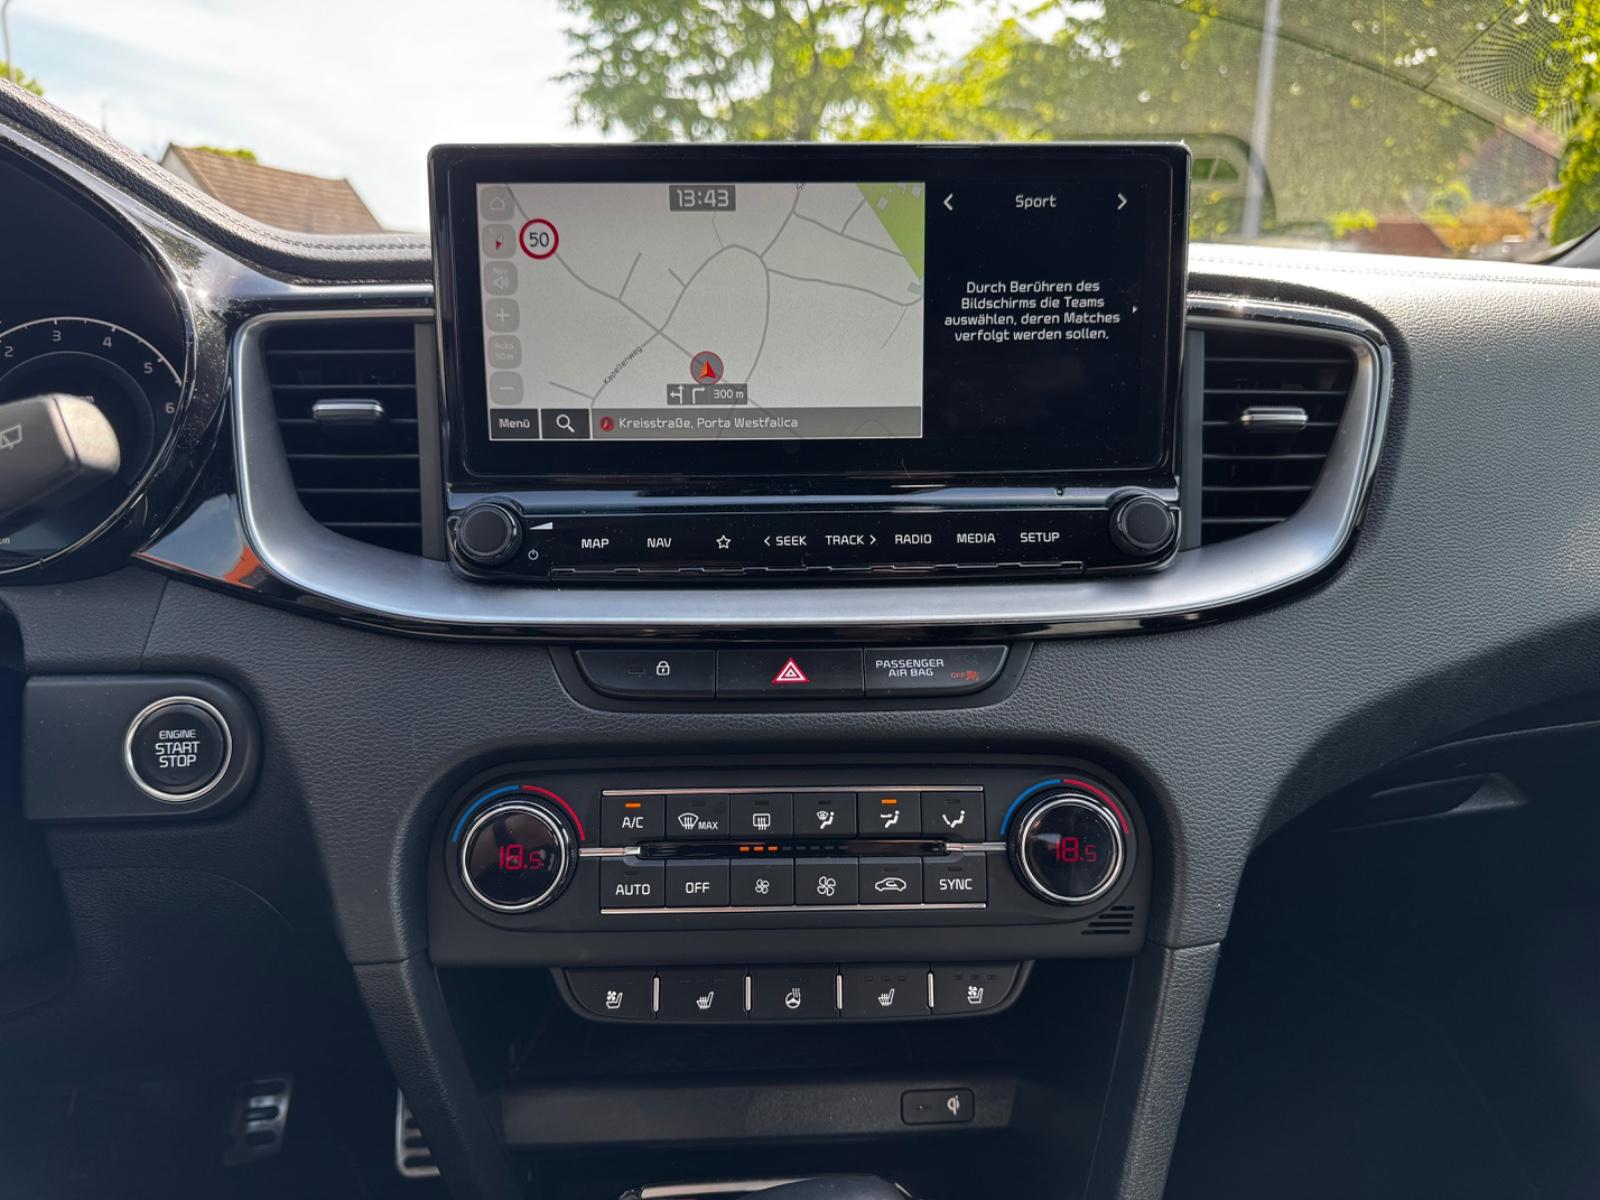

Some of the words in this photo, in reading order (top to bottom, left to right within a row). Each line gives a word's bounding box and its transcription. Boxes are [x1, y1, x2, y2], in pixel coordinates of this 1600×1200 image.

[676, 188, 729, 208] 13:43
[1015, 194, 1056, 210] Sport
[528, 231, 550, 247] 50
[966, 281, 1006, 294] Durch
[1010, 280, 1072, 293] Berühren
[1076, 280, 1100, 292] des
[961, 297, 1036, 309] Bildschirms
[1040, 297, 1060, 309] die
[1064, 296, 1105, 308] Teams
[944, 313, 1017, 326] auswählen,
[1021, 313, 1060, 325] deren
[1064, 312, 1121, 324] Matches
[52, 330, 61, 342] 3
[955, 329, 1010, 343] verfolgt
[1013, 328, 1062, 341] werden
[1065, 327, 1109, 340] sollen.
[102, 337, 112, 349] 4
[4, 346, 14, 358] 2
[144, 363, 153, 374] 5
[602, 345, 643, 385] Kapellenweg
[713, 389, 734, 399] 300
[736, 391, 744, 399] m
[165, 403, 175, 414] 6
[499, 417, 530, 429] Menü
[619, 416, 694, 430] Kreisstraße,
[697, 416, 731, 429] Porta
[734, 416, 798, 429] Westfalica
[647, 537, 672, 548] NAV
[775, 535, 807, 547] SEEK
[825, 534, 865, 546] TRACK
[895, 533, 932, 545] RADIO
[956, 532, 996, 544] MEDIA
[1020, 531, 1060, 543] SETUP
[581, 538, 609, 549] MAP
[875, 658, 944, 669] PASSENGER
[888, 668, 908, 678] AIR
[910, 667, 934, 677] BAG
[159, 729, 197, 740] ENGINE
[155, 741, 200, 755] START
[159, 754, 197, 768] STOP
[621, 816, 644, 829] A/C
[698, 820, 718, 830] MAX
[615, 883, 651, 896] AUTO
[684, 882, 710, 894] OFF
[939, 878, 973, 891] SYNC
